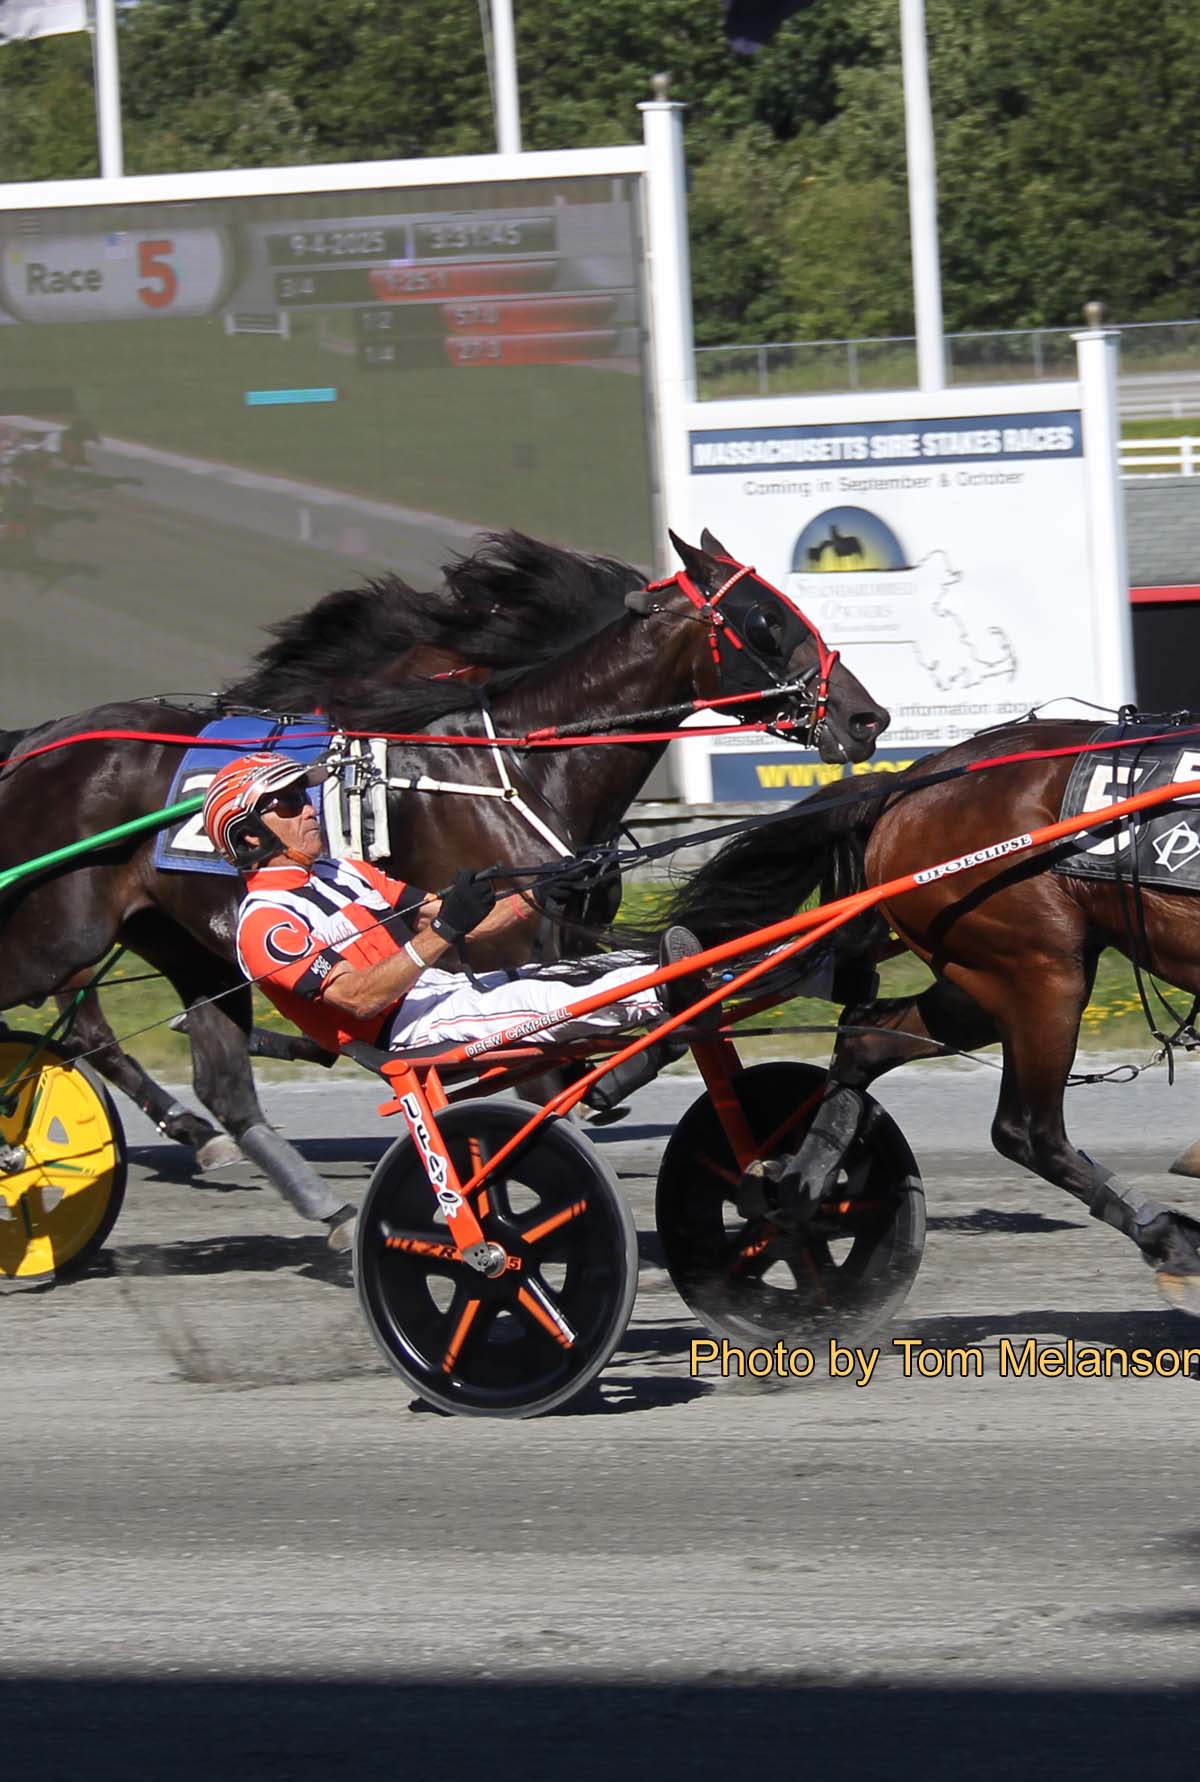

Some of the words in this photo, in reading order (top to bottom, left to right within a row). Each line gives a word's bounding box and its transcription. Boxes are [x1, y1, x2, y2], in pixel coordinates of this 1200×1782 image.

[26, 262, 103, 295] Race
[136, 239, 178, 309] 5
[744, 480, 812, 498] Coming
[838, 475, 931, 494] September
[958, 470, 1024, 488] October
[465, 1035, 502, 1059] DREW
[505, 1007, 573, 1041] CAMPBELL
